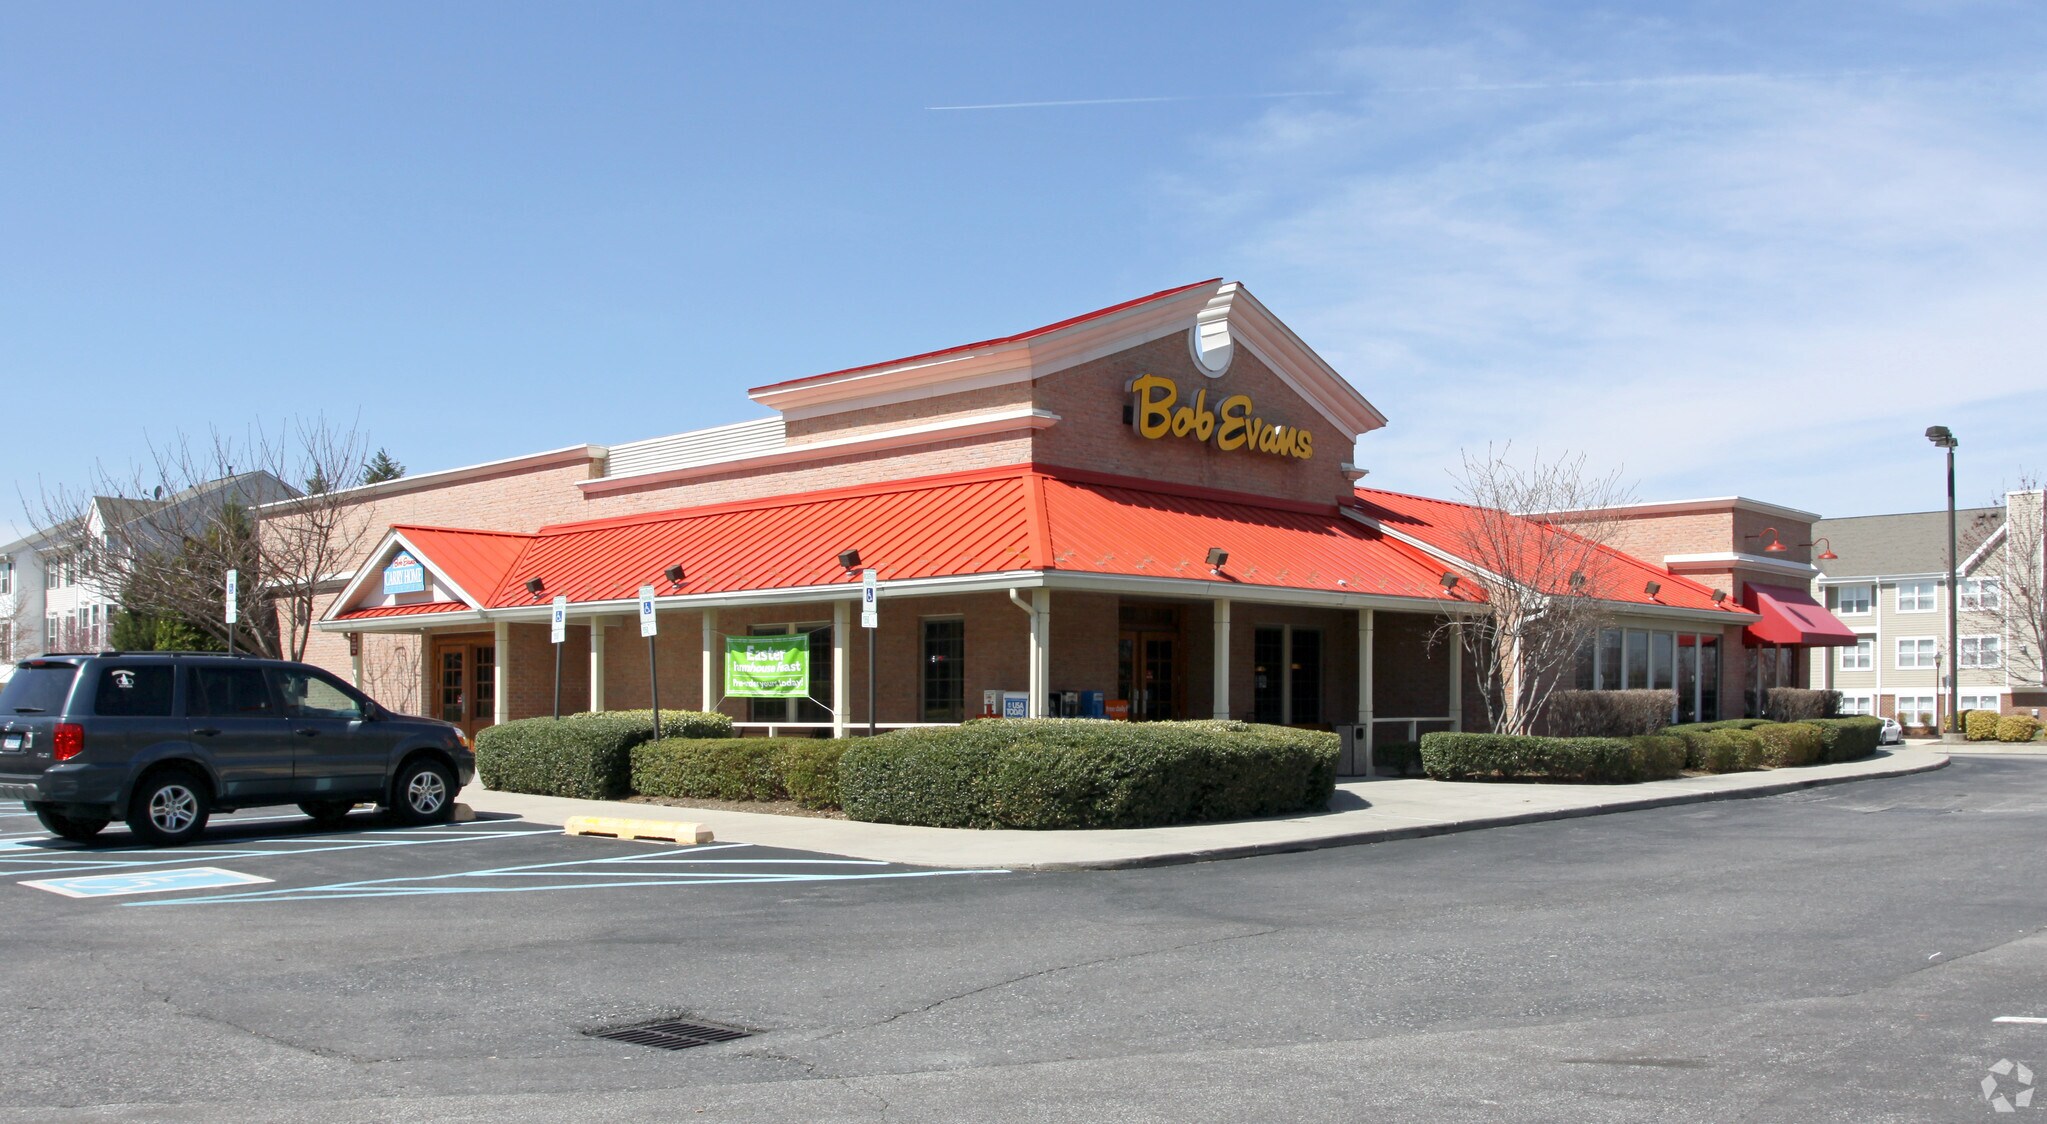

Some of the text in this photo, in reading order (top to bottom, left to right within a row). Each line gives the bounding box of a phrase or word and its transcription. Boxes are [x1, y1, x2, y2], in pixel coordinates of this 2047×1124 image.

[1132, 374, 1313, 460] Bob Evans
[385, 567, 423, 586] CARRY HOME
[746, 645, 786, 661] Easter
[778, 677, 804, 689] today!
[1007, 708, 1025, 716] TODAY
